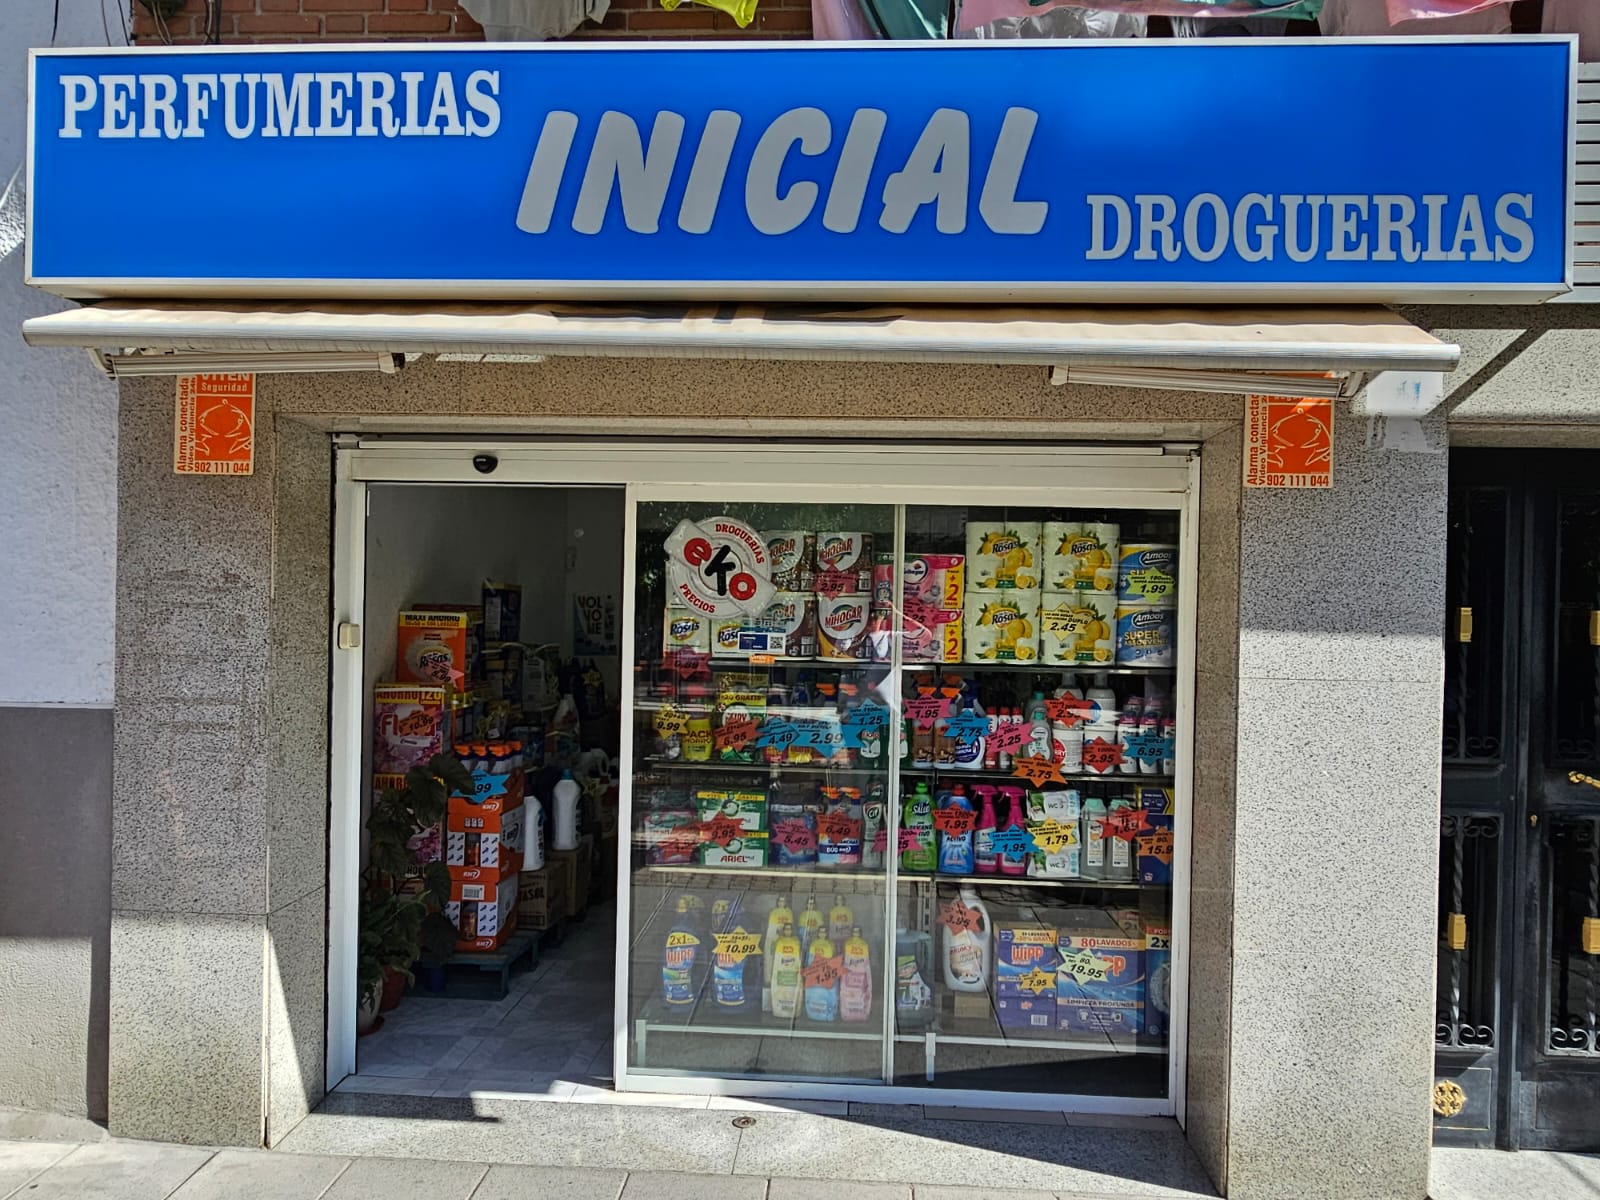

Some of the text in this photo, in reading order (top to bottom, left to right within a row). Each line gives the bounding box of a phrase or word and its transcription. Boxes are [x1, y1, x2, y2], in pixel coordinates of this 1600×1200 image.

[58, 70, 501, 139] PERFUMERIAS
[516, 107, 1048, 236] INICIAL
[1085, 193, 1534, 263] DROGUERIAS
[201, 382, 247, 392] Seguridad
[177, 377, 189, 471] Alarma conectada
[188, 397, 196, 443] Vigilancia
[1259, 407, 1268, 455] Vigilancia
[195, 462, 250, 473] 902 111 044
[1247, 447, 1258, 485] Alarma
[1258, 458, 1266, 485] Video
[1267, 475, 1329, 486] 902 111 044
[715, 523, 765, 564] DROGUERIAS
[1071, 541, 1097, 554] Rosas
[820, 583, 844, 592] 2.95
[946, 584, 959, 601] 2
[1140, 584, 1166, 594] 1.99
[679, 583, 716, 614] PRECIOS
[1050, 622, 1077, 631] 2.45
[1125, 630, 1160, 640] SUPER
[946, 638, 958, 656] 2
[915, 709, 939, 719] 1.95
[657, 721, 680, 731] 9.99
[858, 716, 882, 725] 1.25
[768, 733, 792, 744] 4.49
[810, 732, 843, 744] 2.99
[997, 735, 1021, 748] 2.25
[1138, 748, 1164, 757] 6.95
[1088, 754, 1114, 763] 2.95
[1026, 768, 1053, 779] 2.75
[944, 820, 968, 829] 1.95
[783, 835, 809, 846] 5.45
[1045, 834, 1069, 845] 1.79
[1002, 843, 1026, 853] 1.95
[1147, 845, 1173, 855] 15.9
[721, 855, 748, 863] ARIEL
[670, 934, 686, 946] 2x1
[1081, 938, 1132, 948] 80 LAVADOS
[1150, 937, 1169, 949] 2x
[725, 944, 756, 954] 10.99
[1070, 964, 1104, 978] 19.95
[1029, 979, 1047, 987] 7.95
